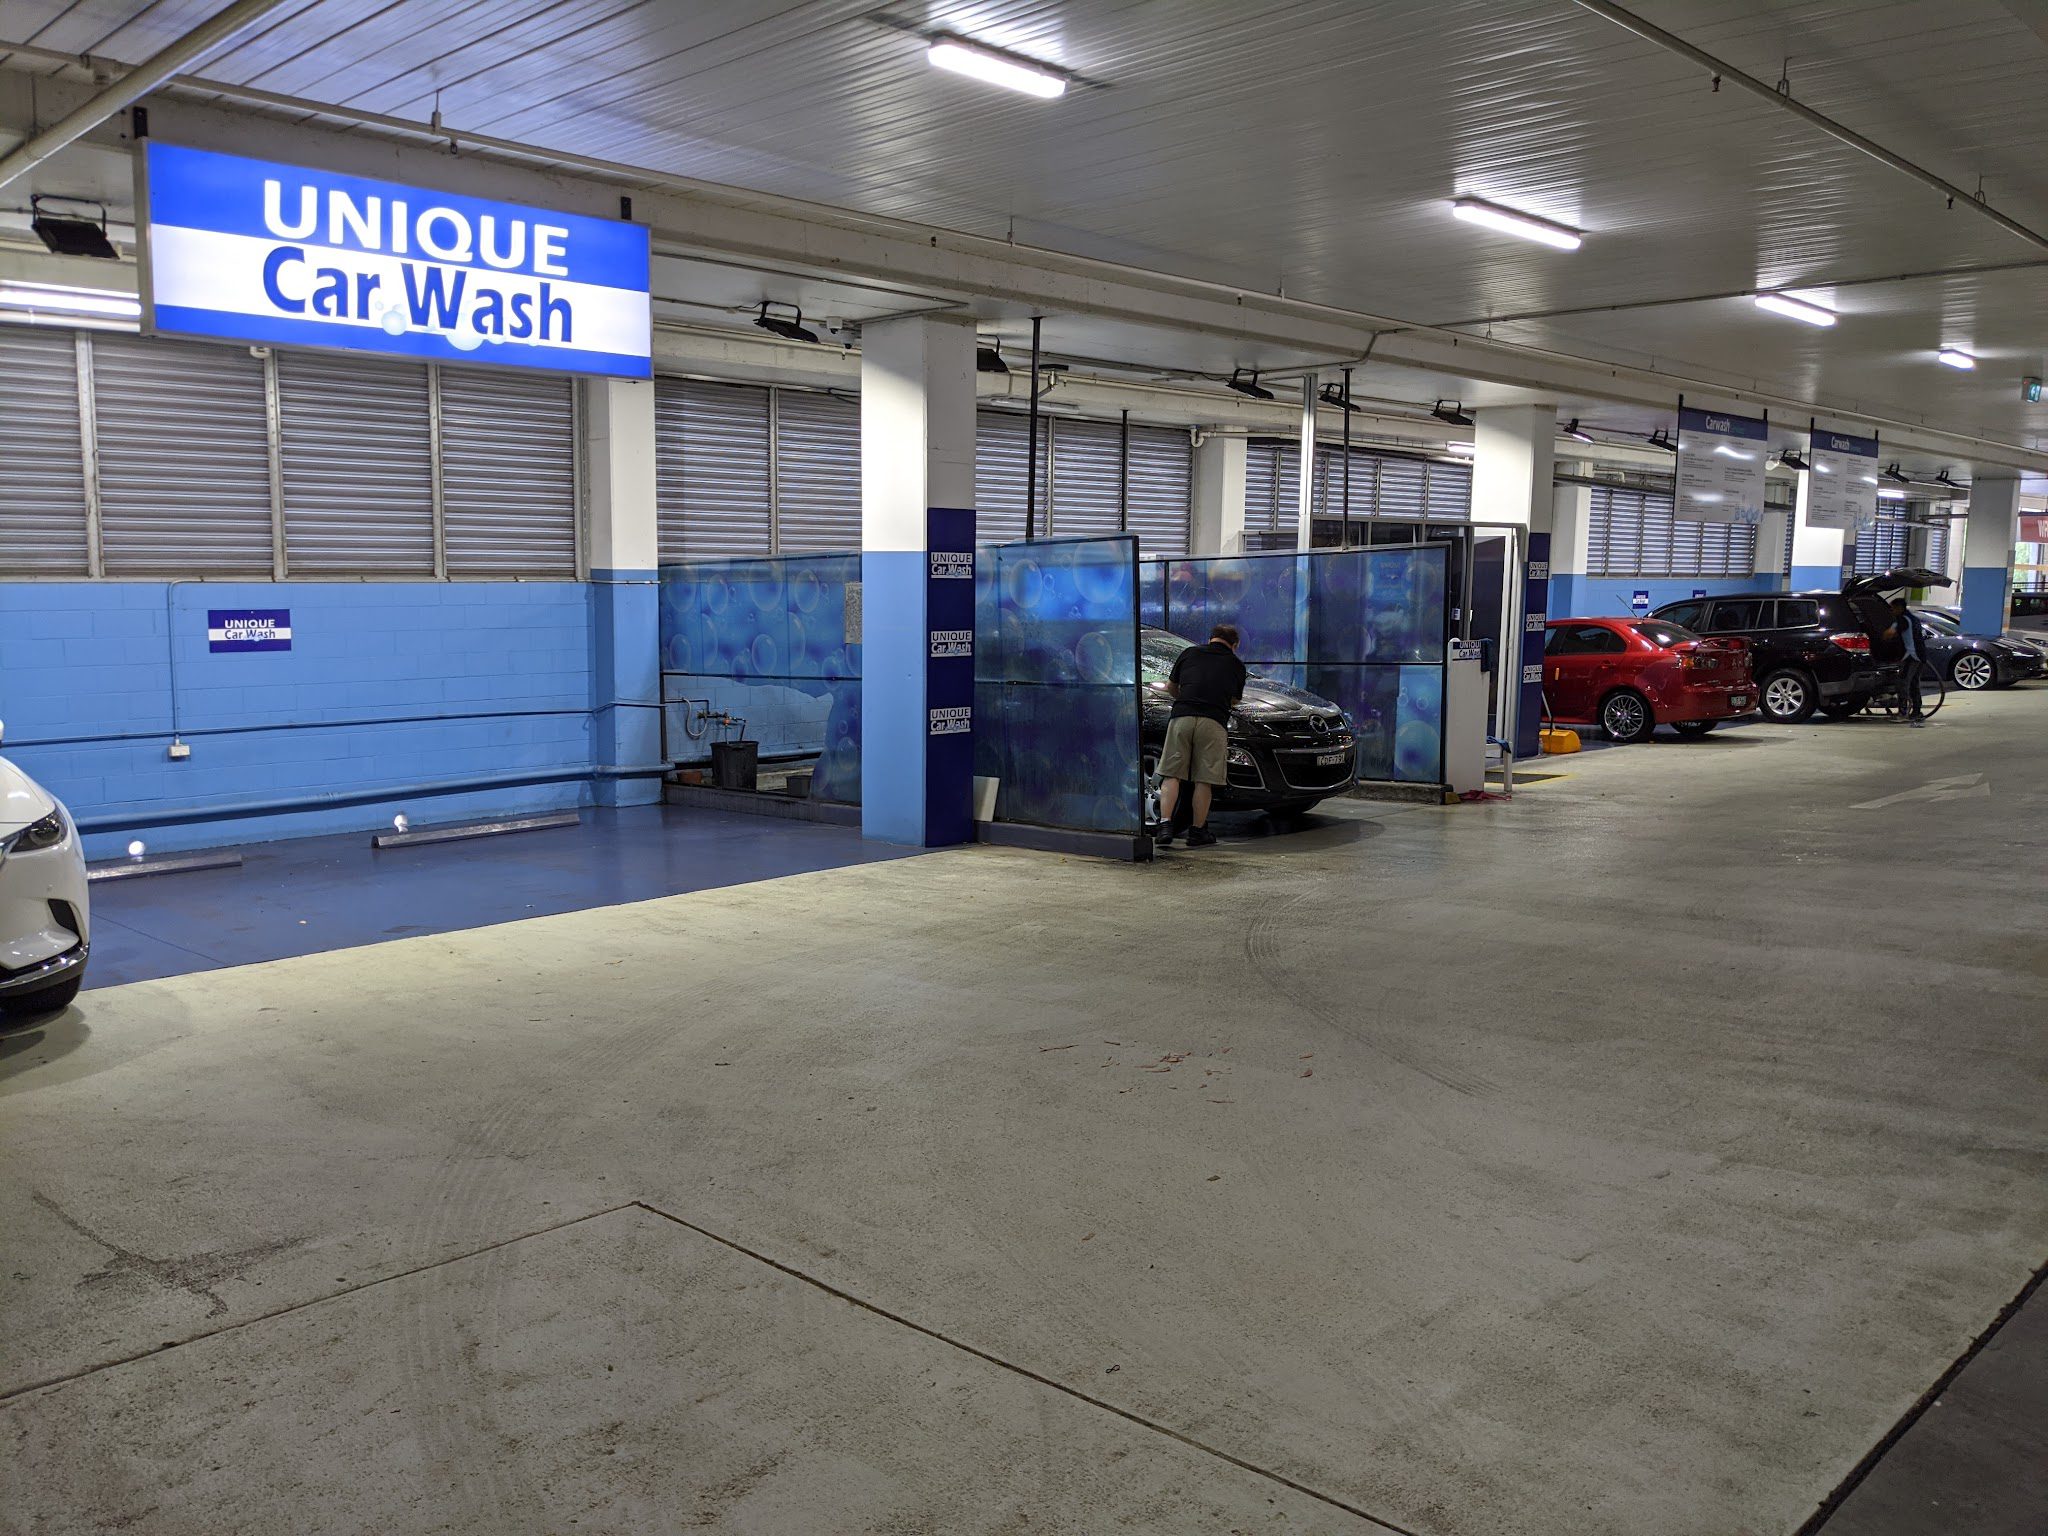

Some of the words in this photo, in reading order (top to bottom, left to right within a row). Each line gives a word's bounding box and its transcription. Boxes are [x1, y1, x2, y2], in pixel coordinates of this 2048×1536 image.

[263, 179, 569, 277] UNIQUE
[263, 246, 381, 320] Car
[401, 262, 572, 343] Wash
[1705, 415, 1730, 433] Carwash
[1831, 436, 1850, 450] Carwash
[932, 553, 971, 563] UNIQUE
[931, 564, 946, 575] Car
[947, 564, 972, 575] Wash
[224, 619, 276, 629] UNIQUE
[224, 629, 243, 640] Car
[246, 629, 276, 639] Wash
[932, 631, 971, 641] UNIQUE
[931, 642, 946, 653] Car
[947, 642, 971, 653] Wash
[1460, 641, 1481, 649] UNIQU
[931, 708, 970, 718] UNIQUE
[930, 720, 946, 731] Car
[946, 718, 970, 730] Wash
